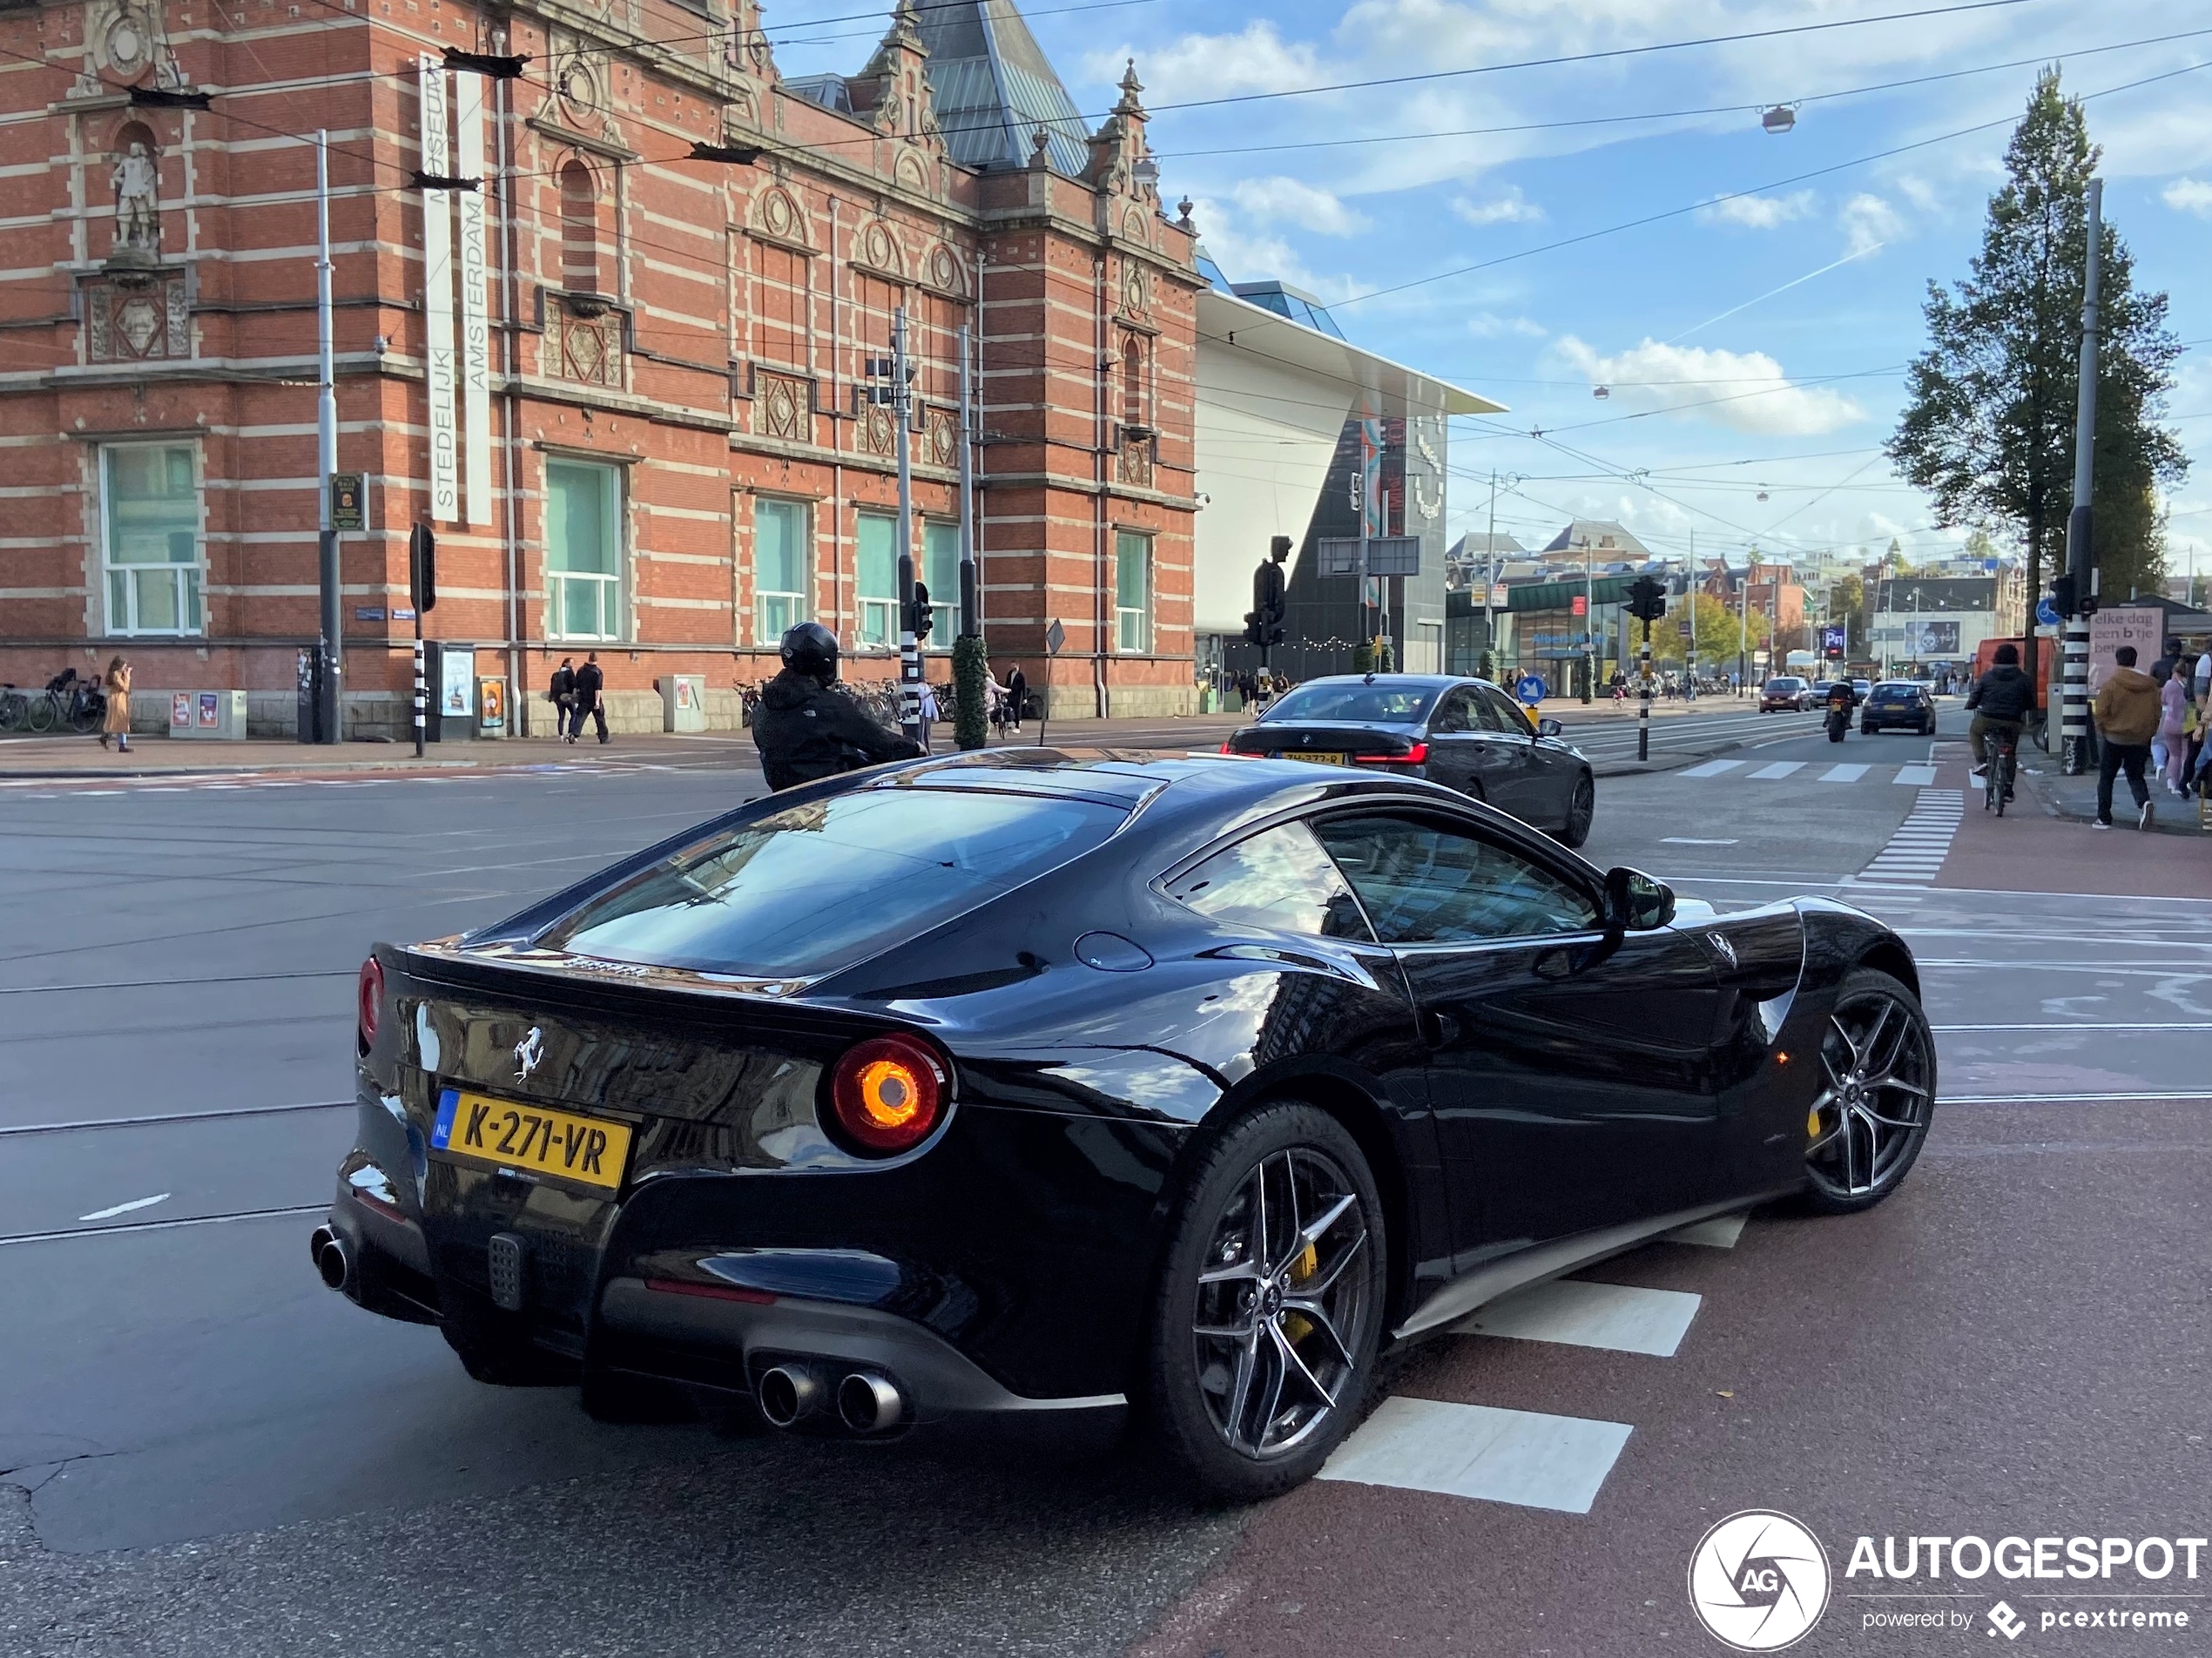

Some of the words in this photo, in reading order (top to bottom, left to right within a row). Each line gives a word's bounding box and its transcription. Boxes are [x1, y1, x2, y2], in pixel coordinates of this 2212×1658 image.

[426, 59, 446, 205] MUSEUM
[465, 200, 486, 389] AMSTERDAM
[434, 350, 454, 507] STEDELIJK
[2094, 612, 2124, 624] elke
[2128, 612, 2154, 627] dag
[2094, 630, 2120, 639] een
[2094, 643, 2119, 653] bet
[435, 1123, 448, 1138] NL
[465, 1102, 607, 1175] K-271-VR
